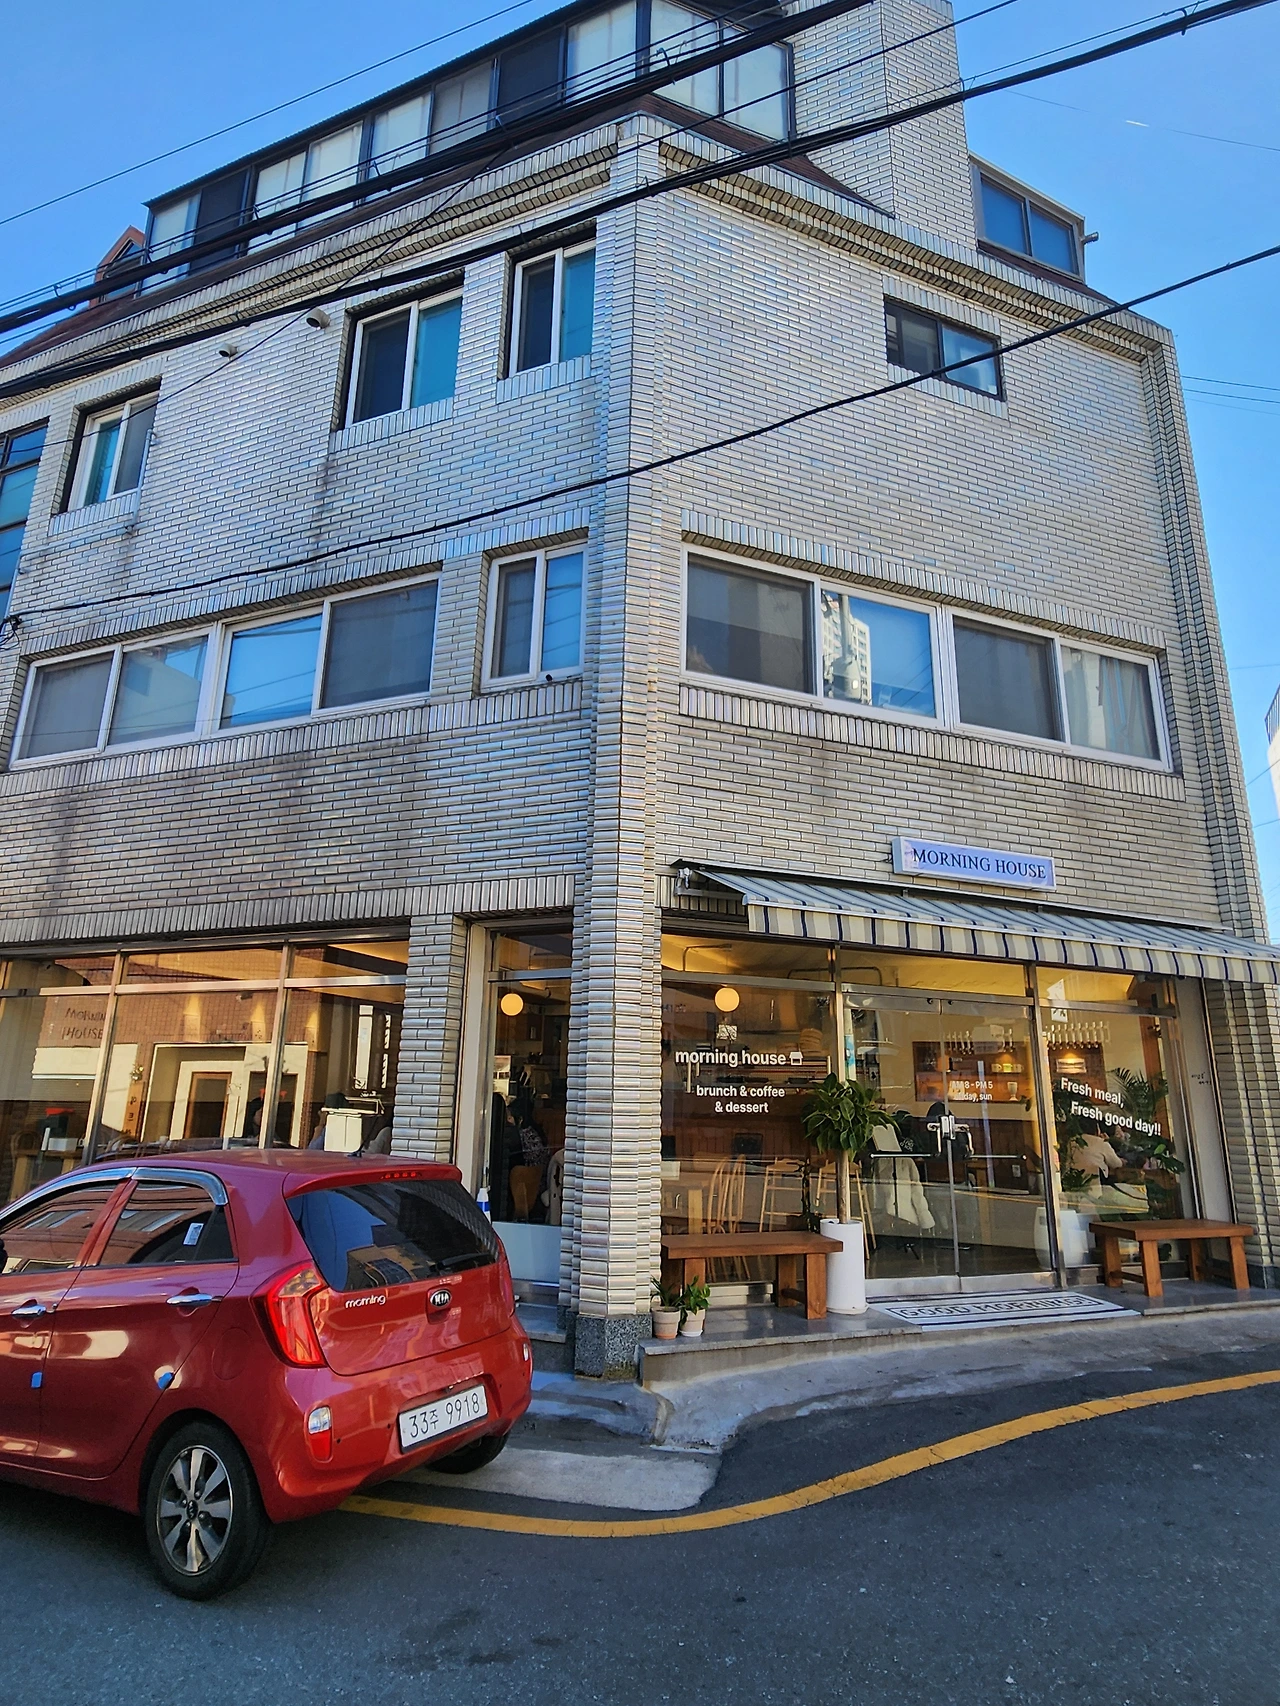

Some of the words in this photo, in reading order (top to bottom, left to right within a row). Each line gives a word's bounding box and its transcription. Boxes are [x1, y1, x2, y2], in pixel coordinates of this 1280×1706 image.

[913, 848, 990, 872] MORNING
[995, 860, 1046, 879] HOUSE
[675, 1049, 738, 1067] morning
[741, 1050, 787, 1065] house
[696, 1085, 738, 1097] brunch
[740, 1086, 748, 1097] &
[750, 1086, 785, 1097] coffee
[1060, 1077, 1092, 1098] Fresh
[1095, 1088, 1124, 1109] meal,
[715, 1101, 723, 1113] &
[725, 1101, 769, 1113] dessert
[1071, 1101, 1103, 1121] Fresh
[1105, 1112, 1133, 1129] good
[1135, 1119, 1161, 1137] day!!
[345, 1294, 386, 1308] morning
[433, 1291, 450, 1306] KIA
[900, 1306, 970, 1316] GOOD
[408, 1409, 440, 1438] 33주
[445, 1392, 480, 1424] 9918
